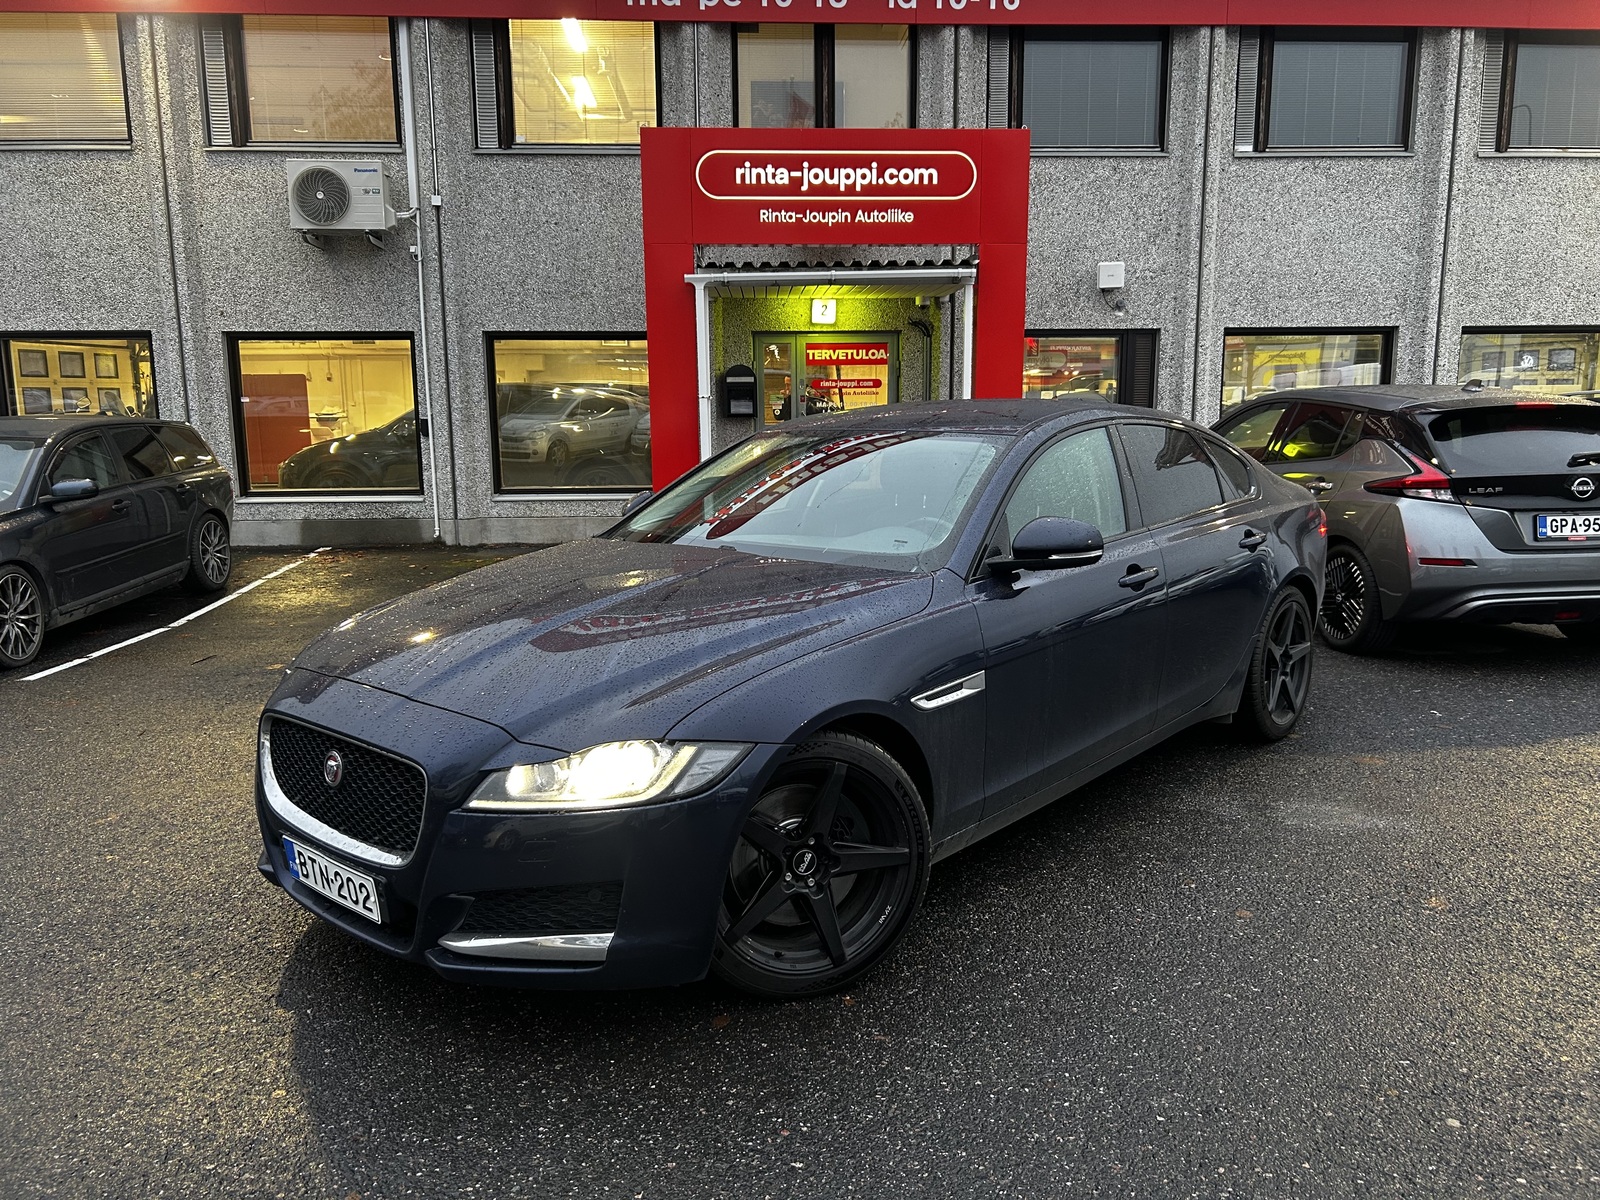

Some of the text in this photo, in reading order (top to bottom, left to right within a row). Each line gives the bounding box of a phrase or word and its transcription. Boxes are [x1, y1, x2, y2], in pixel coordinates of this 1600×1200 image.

[736, 162, 938, 191] rinta-jouppi.com
[760, 209, 914, 226] Rinta-Joupin Autoliike
[820, 304, 828, 316] 2
[806, 349, 887, 360] TERVETULOA
[936, 691, 964, 704] JAGUAR
[902, 794, 924, 852] MICHELIN
[297, 850, 374, 914] BTN-202
